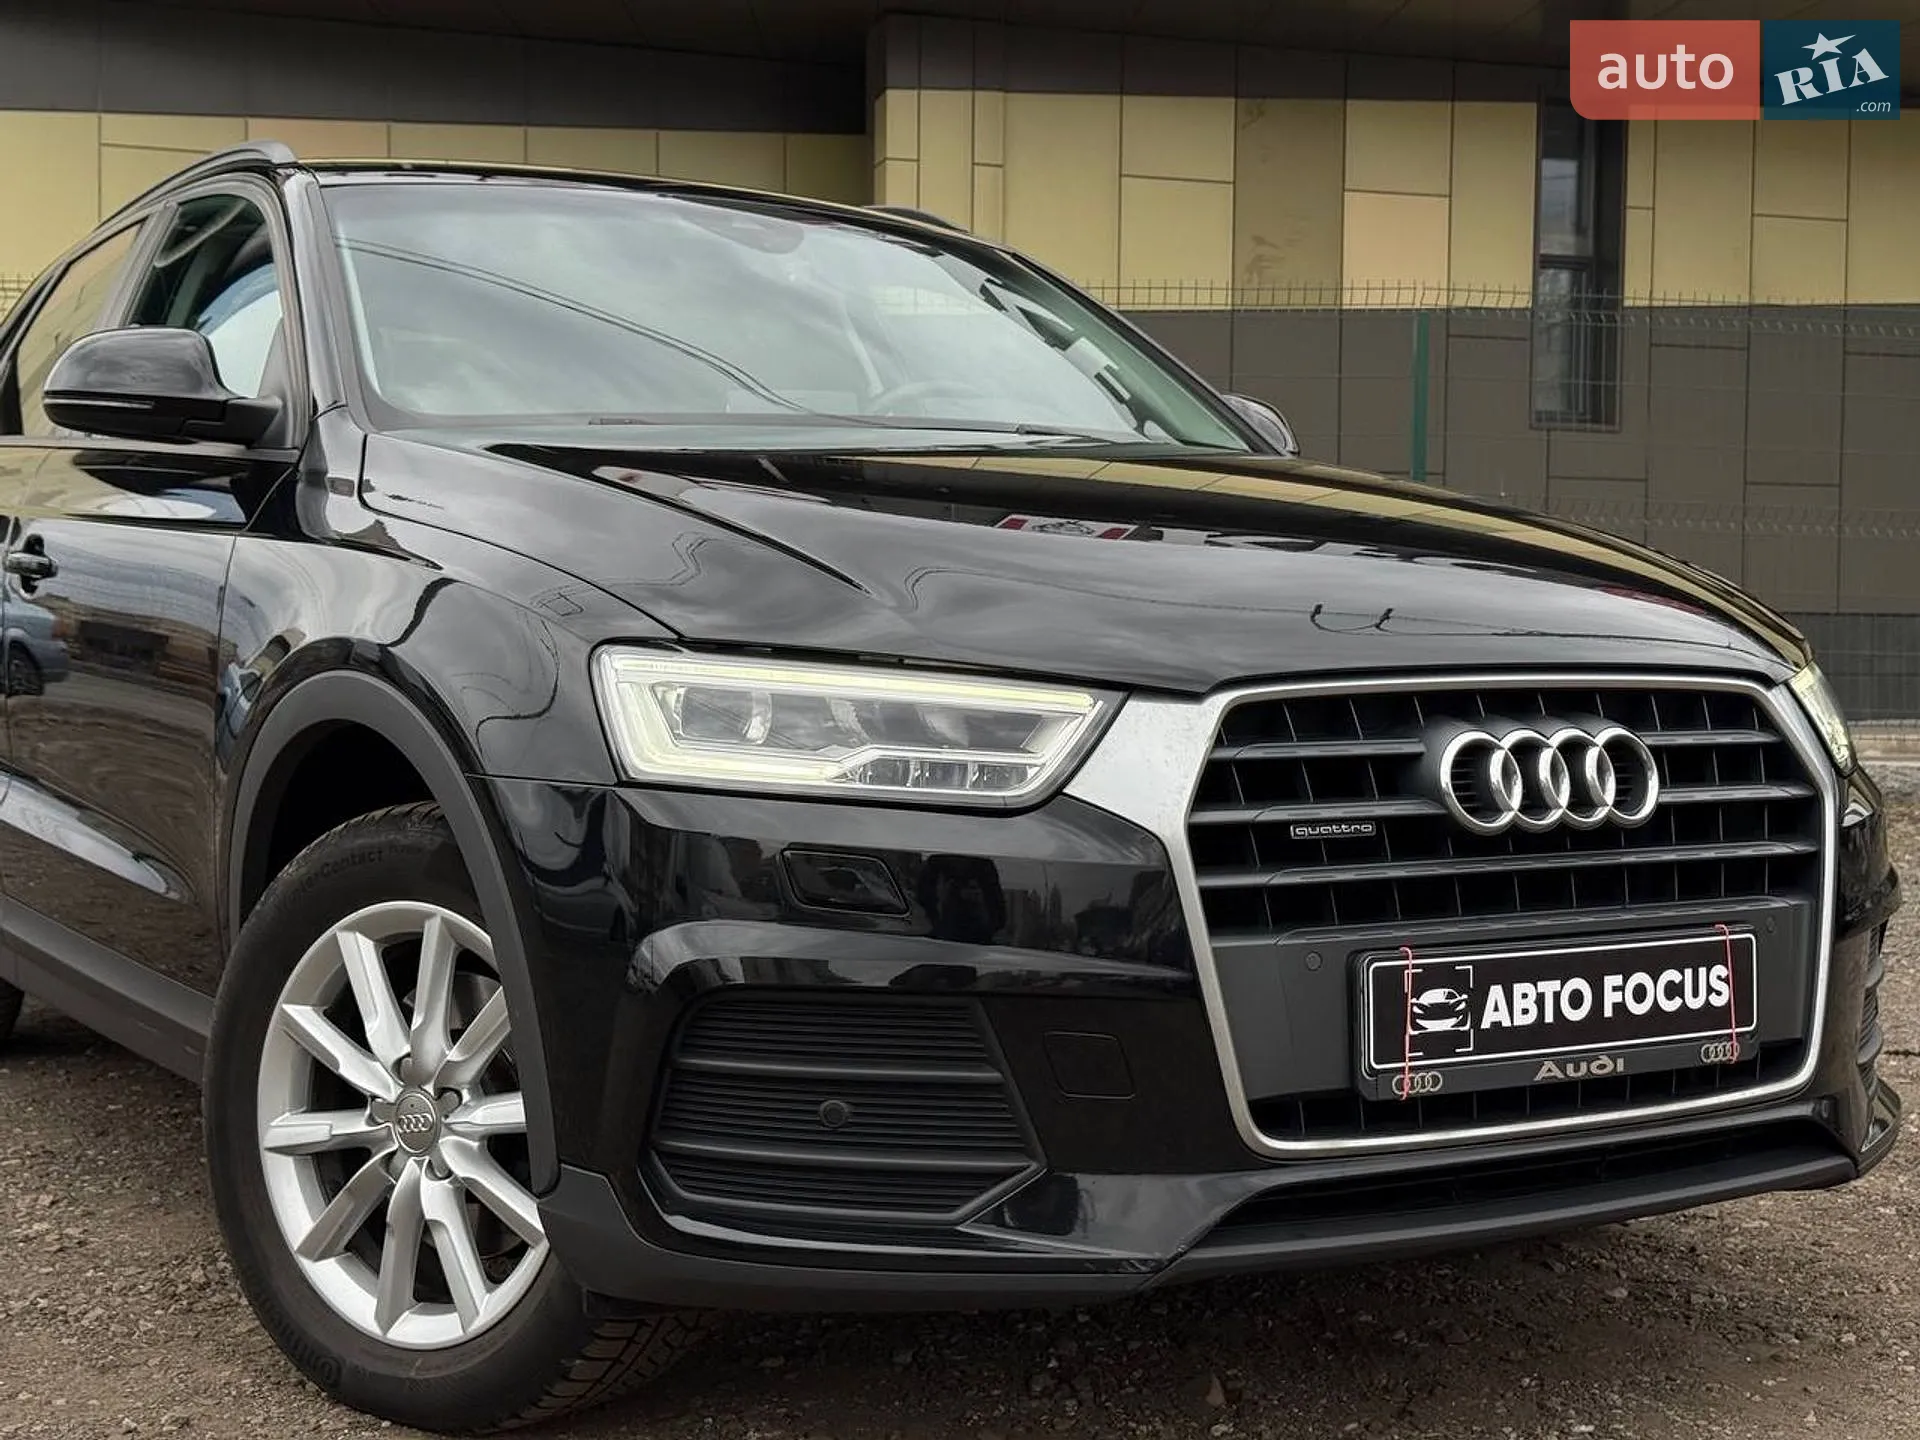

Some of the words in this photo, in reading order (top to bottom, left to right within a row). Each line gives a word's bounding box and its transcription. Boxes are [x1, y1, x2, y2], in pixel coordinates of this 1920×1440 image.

[1295, 824, 1372, 838] quattro
[1603, 964, 1730, 1019] FOCUS
[1533, 1055, 1625, 1082] Audi
